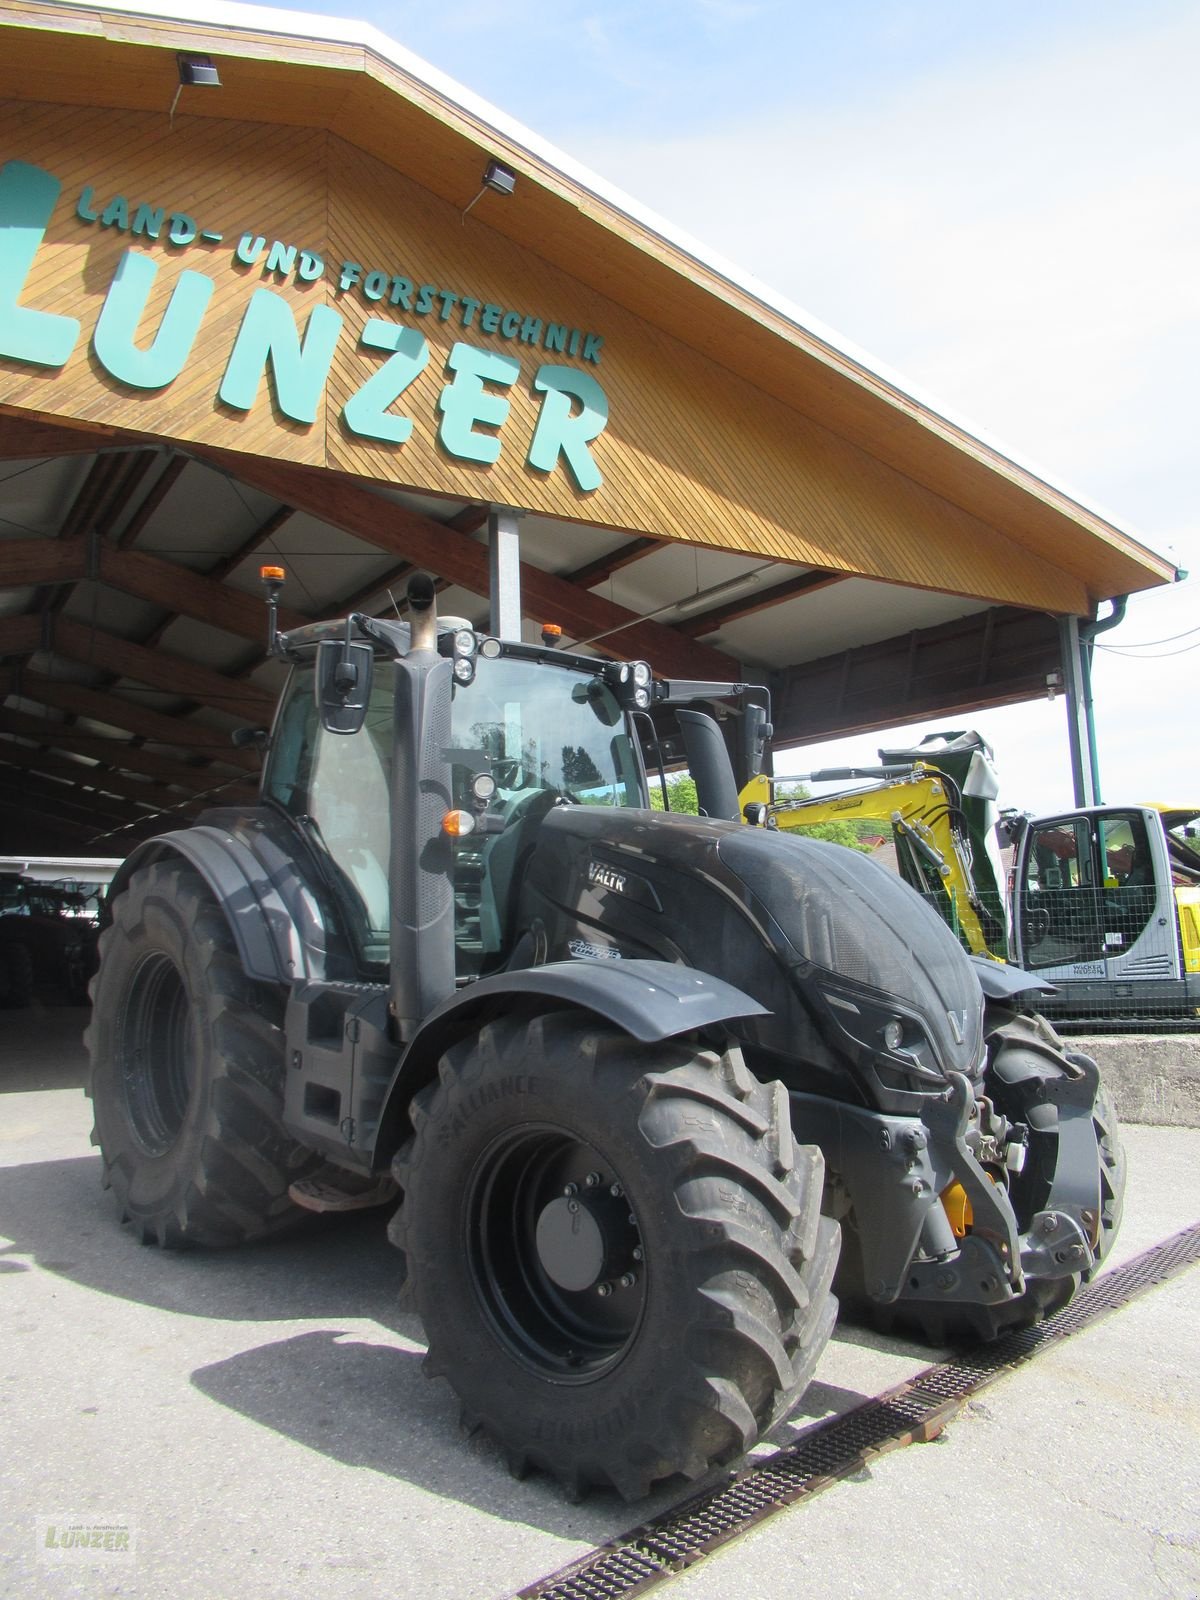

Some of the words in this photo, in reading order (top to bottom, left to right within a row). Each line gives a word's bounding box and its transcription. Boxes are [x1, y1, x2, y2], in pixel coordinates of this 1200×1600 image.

[0, 160, 609, 492] LUNZER
[76, 186, 222, 247] LAND-
[237, 232, 325, 282] UND
[338, 261, 605, 364] FORSTTECHNIK
